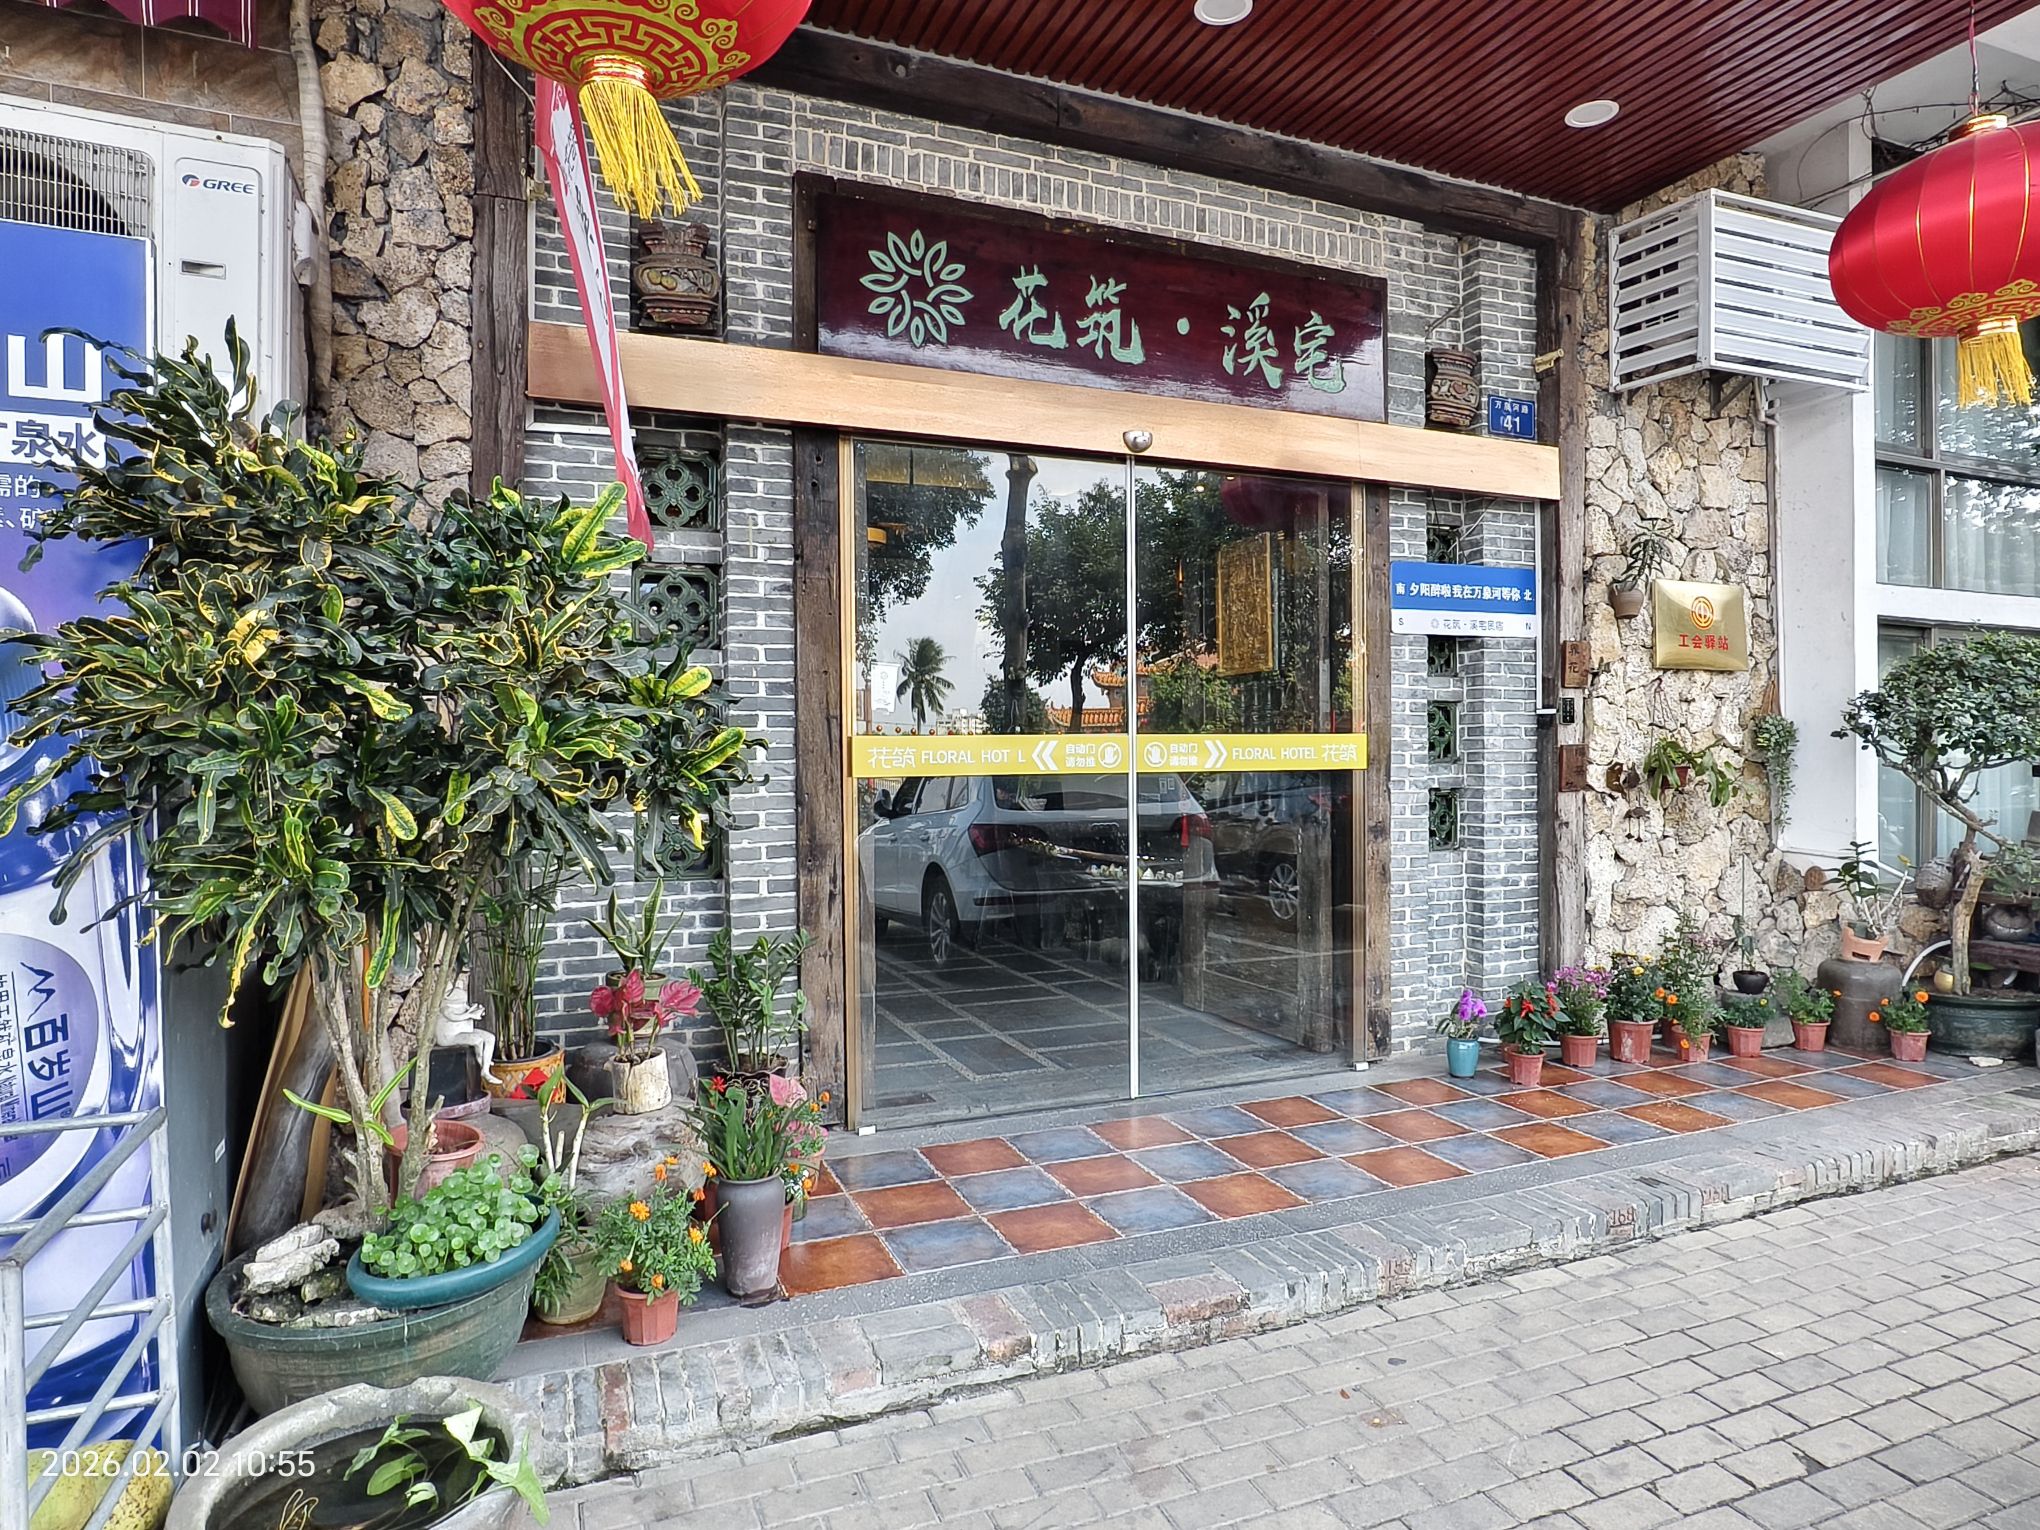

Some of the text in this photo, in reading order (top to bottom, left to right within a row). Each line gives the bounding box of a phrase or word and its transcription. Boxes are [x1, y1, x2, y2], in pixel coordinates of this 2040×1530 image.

[203, 179, 255, 194] GREE
[1503, 415, 1520, 432] 41
[0, 419, 100, 459] 泉水
[1523, 589, 1533, 601] 北
[1398, 617, 1404, 626] S
[1525, 622, 1532, 631] N
[1678, 634, 1729, 651] 工会驿站
[1065, 743, 1096, 755] 自动门
[1169, 743, 1199, 754] 自动门
[1232, 744, 1357, 763] FLORAL HOTEL 花筑
[867, 746, 916, 769] 花筑
[921, 749, 975, 764] FLORAL
[24, 1013, 73, 1121] 百岁山
